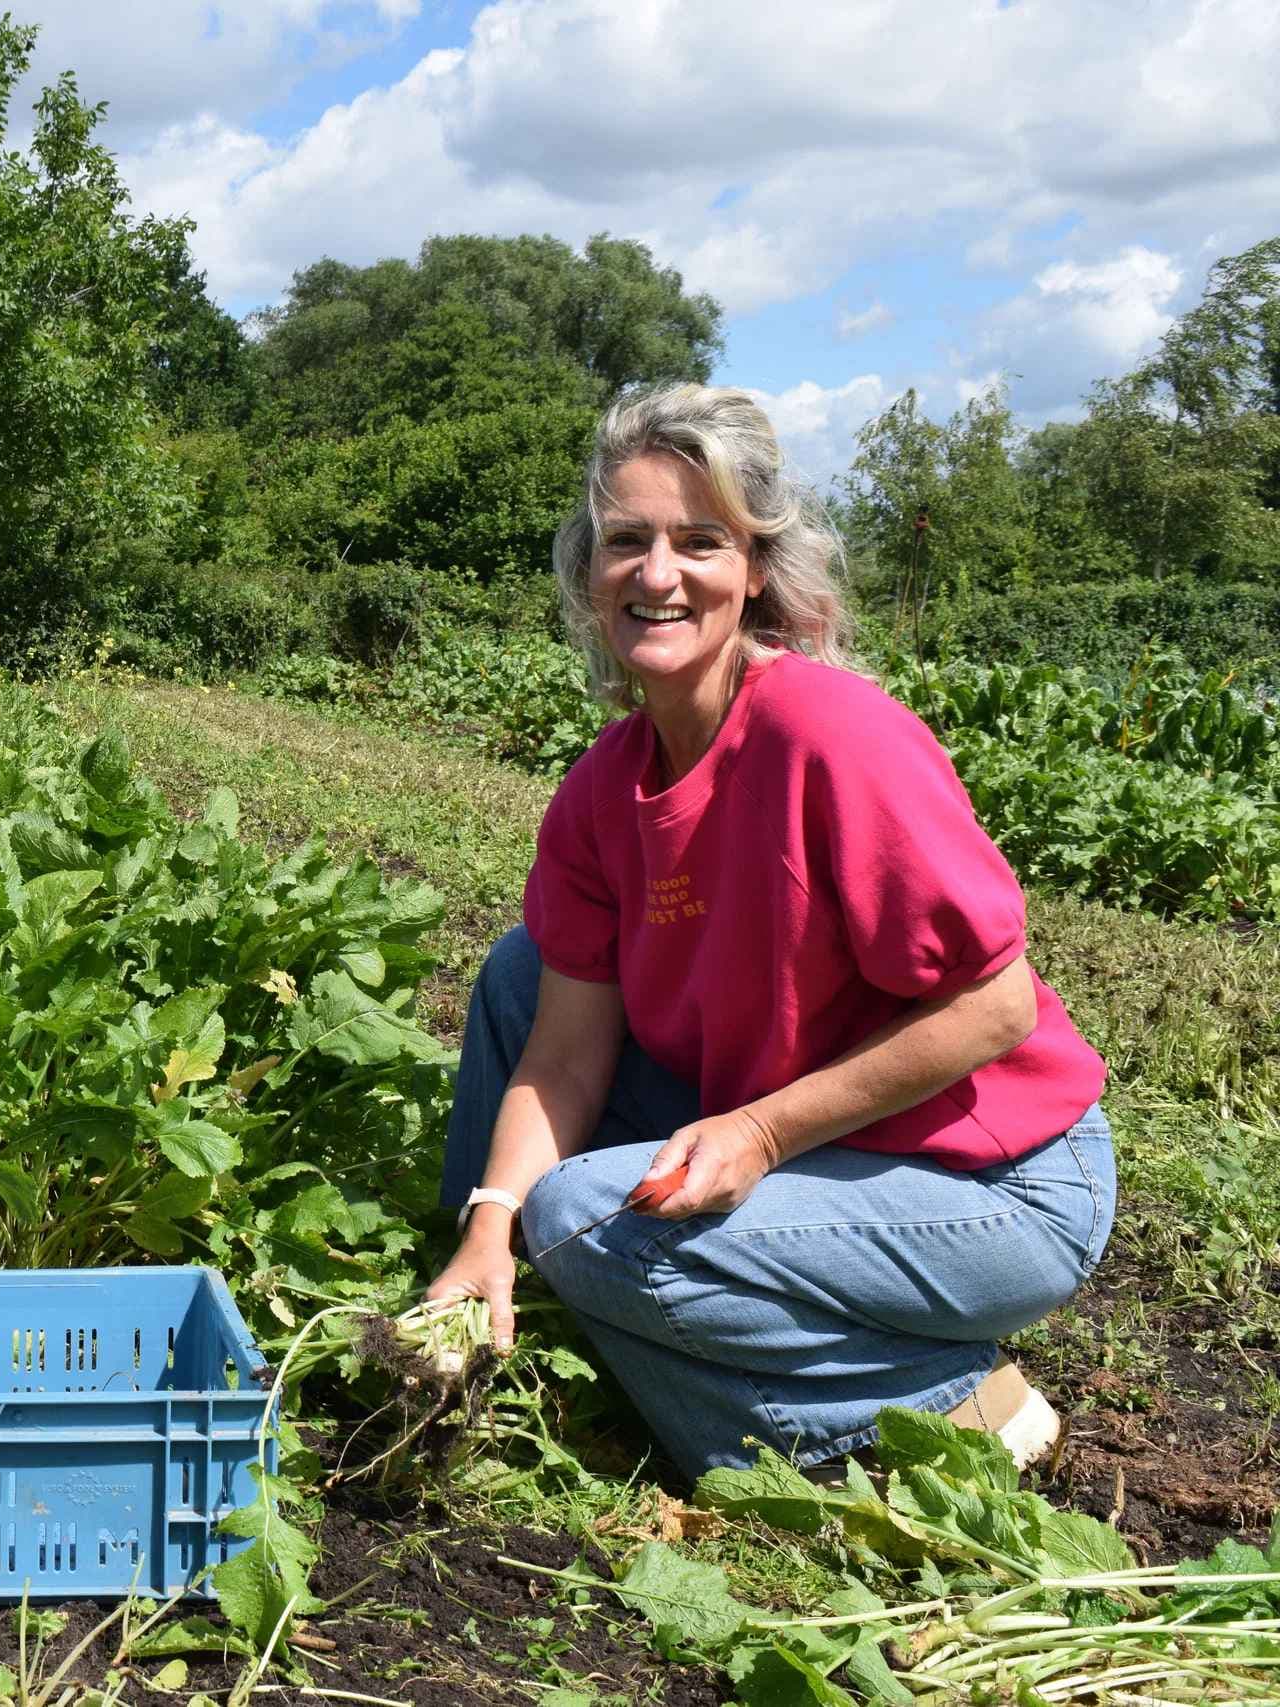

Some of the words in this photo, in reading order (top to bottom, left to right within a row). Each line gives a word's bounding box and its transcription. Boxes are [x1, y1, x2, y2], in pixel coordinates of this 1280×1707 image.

[653, 875, 690, 890] GOOD
[660, 890, 689, 905] BAD
[648, 910, 677, 924] UST
[683, 900, 705, 916] BE
